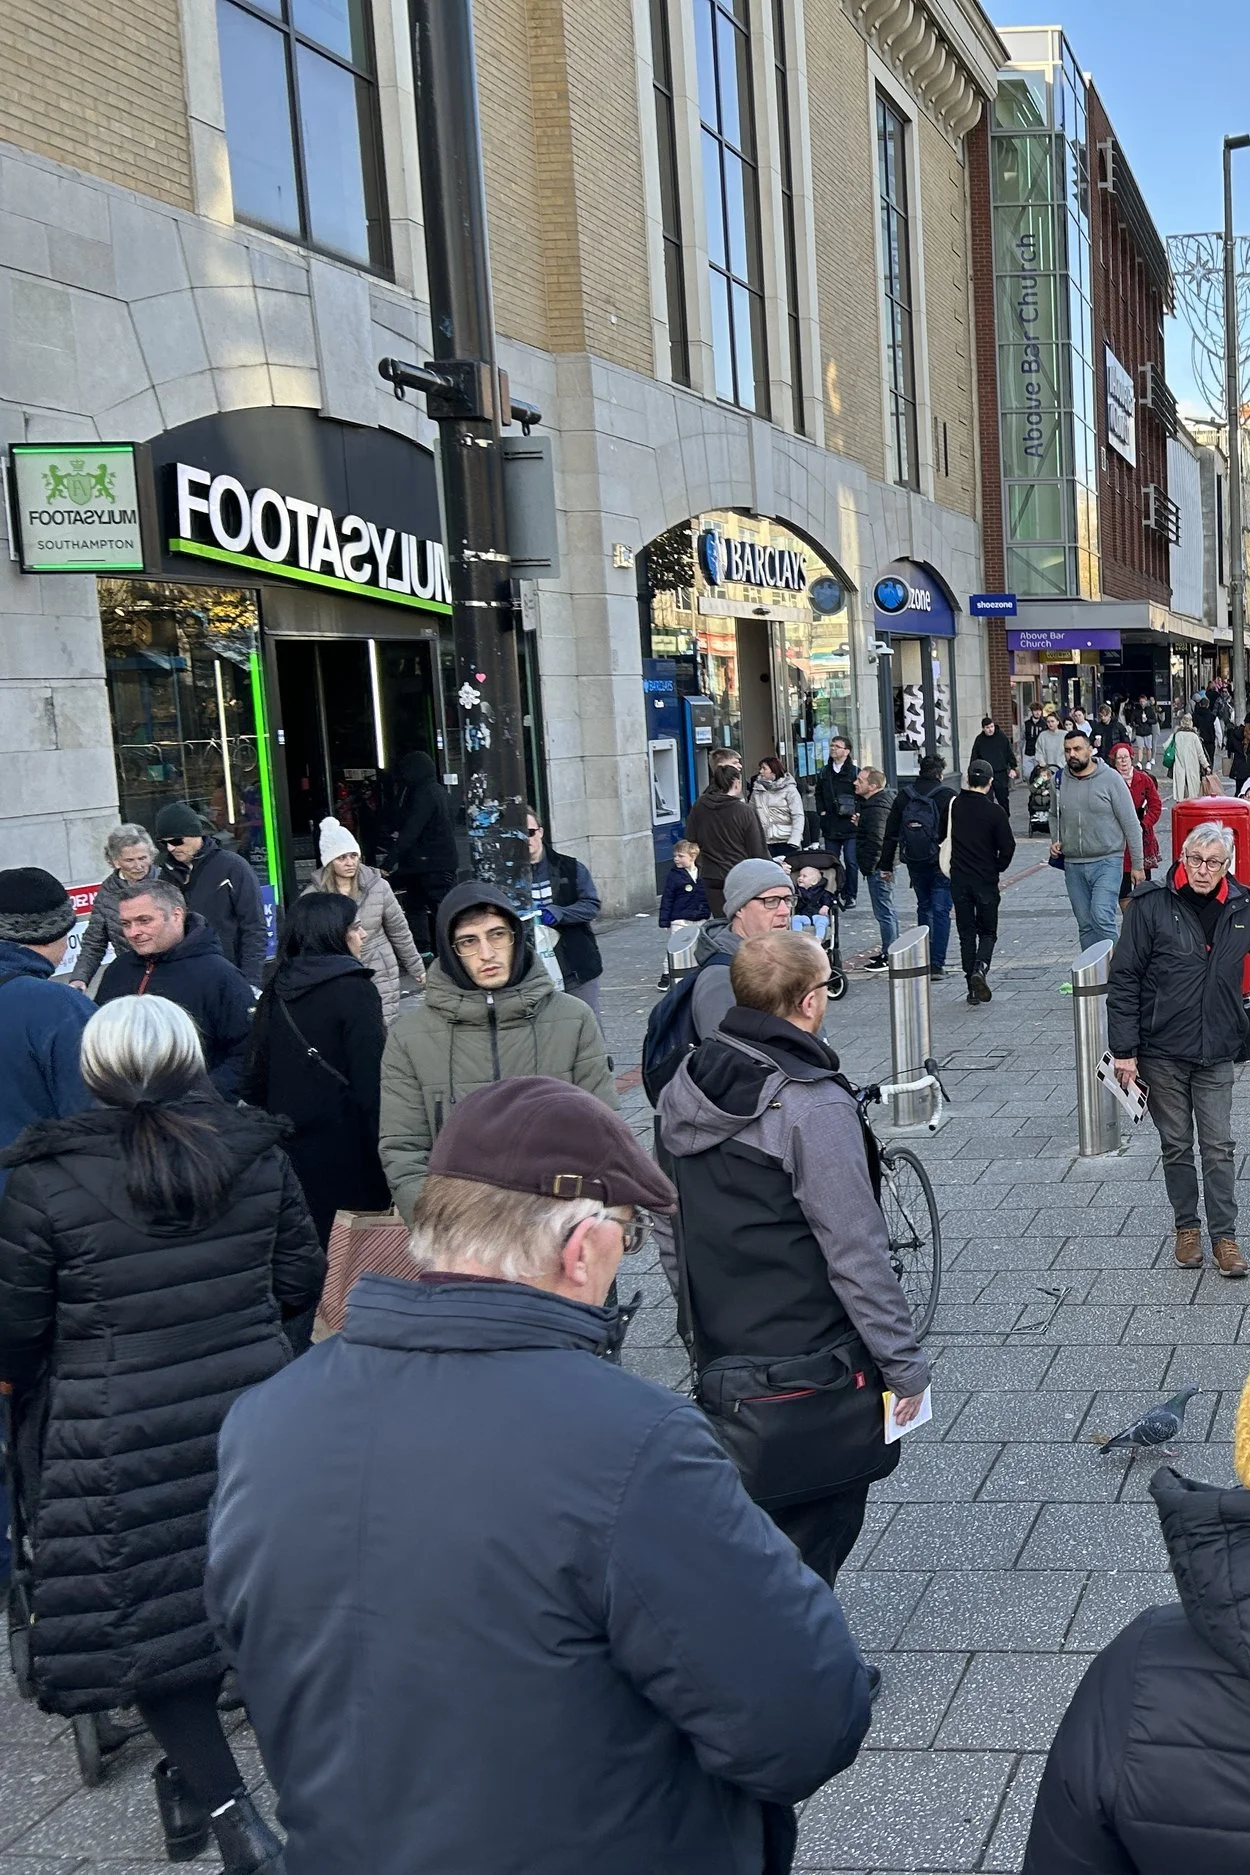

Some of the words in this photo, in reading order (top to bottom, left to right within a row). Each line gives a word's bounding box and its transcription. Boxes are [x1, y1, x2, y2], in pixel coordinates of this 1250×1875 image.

[1015, 233, 1039, 323] Church
[1020, 331, 1041, 374] Bar
[1022, 382, 1044, 459] Above
[28, 509, 137, 526] FOOTASYLUM
[37, 539, 134, 550] SOUTHAMPTON
[730, 540, 807, 591] BARCLAYS
[976, 600, 1013, 609] shoezone
[1019, 632, 1048, 640] Above
[1049, 632, 1065, 640] Bar
[1019, 640, 1052, 648] Church
[648, 680, 674, 692] BARCLAYS
